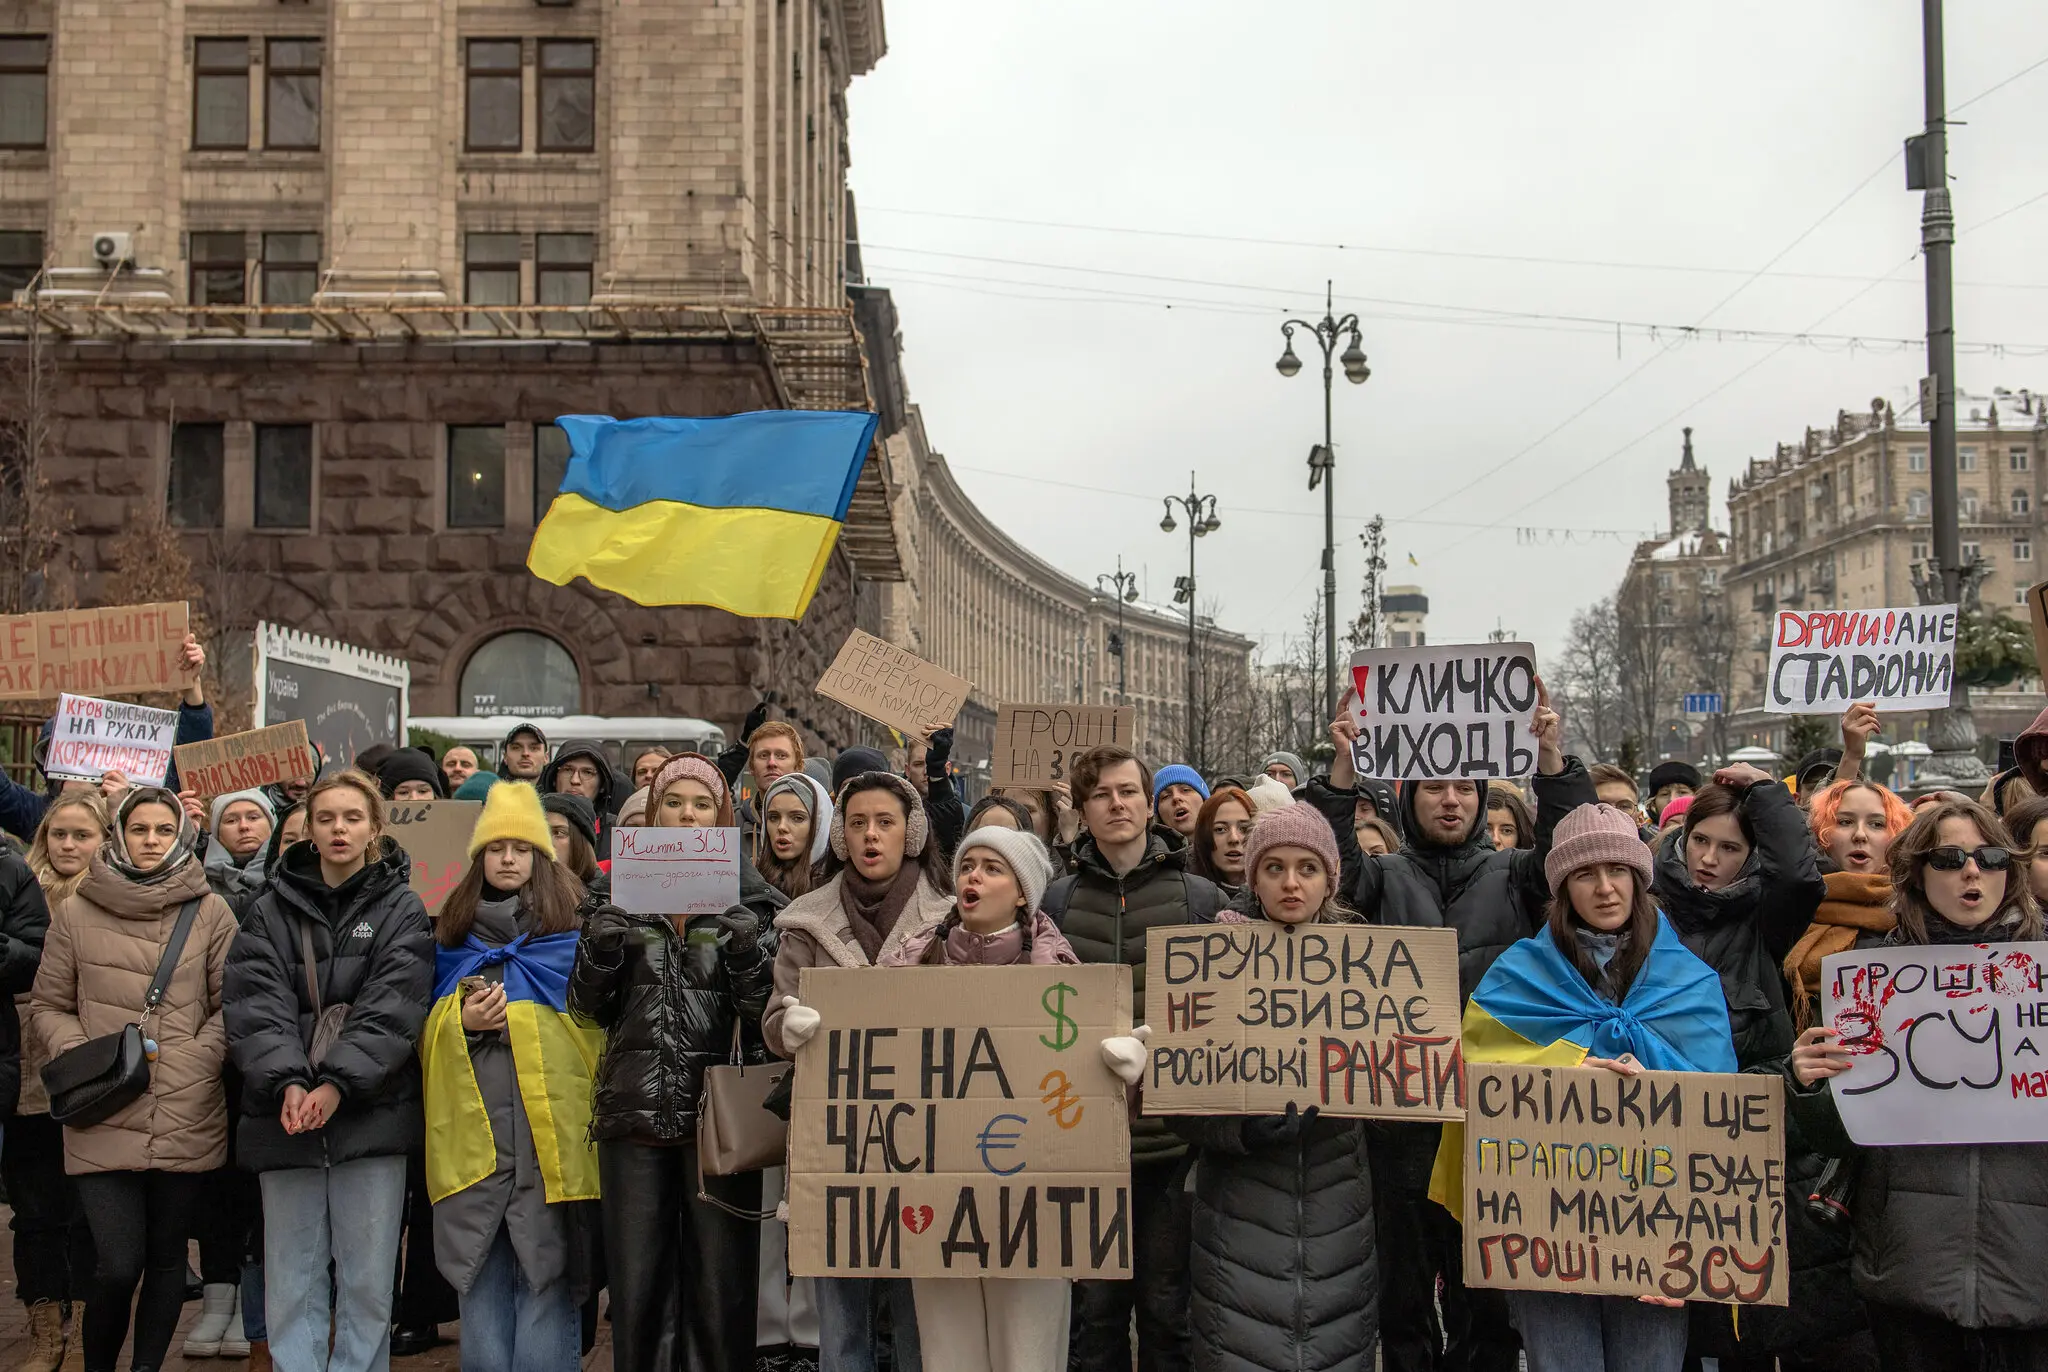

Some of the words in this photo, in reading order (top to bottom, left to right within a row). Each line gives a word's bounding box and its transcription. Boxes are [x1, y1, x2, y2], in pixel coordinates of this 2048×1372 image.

[0, 620, 35, 660] Е
[856, 635, 920, 671] СПЕРШУ
[268, 669, 299, 701] Україна
[474, 695, 495, 704] ТУТ
[825, 668, 877, 699] ПОТІМ
[843, 647, 958, 720] ПЕРЕМОГА
[1377, 655, 1536, 714] КЛИЧКО
[66, 698, 104, 718] КРОВ
[104, 702, 178, 728] ВІЙСЬКОВИХ
[69, 717, 95, 735] НА
[105, 720, 161, 742] РУКАХ
[1010, 709, 1118, 747] ГРОШІ
[1010, 749, 1041, 781] НА
[1352, 720, 1533, 778] ВИХОДЬ
[616, 829, 684, 856] Життя
[352, 931, 373, 939] Kappa
[1165, 931, 1424, 989] БРУКІВКА
[1167, 991, 1218, 1033] НЕ
[1237, 987, 1436, 1036] ЗБИВАЄ
[827, 1027, 898, 1100] НЕ
[920, 1027, 1015, 1100] НА
[1153, 1037, 1308, 1089] РОСІЙСЬКІ
[1319, 1032, 1466, 1111] РАКЕТИ
[1839, 1007, 2003, 1095] ЗСУ
[1478, 1068, 1682, 1132] СКІЛЬКИ
[1703, 1091, 1771, 1140] ЩЕ
[2010, 1069, 2048, 1099] ма
[826, 1102, 937, 1174] ЧАСІ
[1476, 1139, 1679, 1192] ПРАПОРЦІВ
[1688, 1152, 1784, 1200] БУДЕ
[1477, 1188, 1522, 1226] НА
[1550, 1187, 1784, 1247] МАЙДАНІ?
[1478, 1233, 1600, 1283] ГРОШІ
[1612, 1254, 1653, 1288] НА
[1659, 1240, 1775, 1304] ЗСУ
